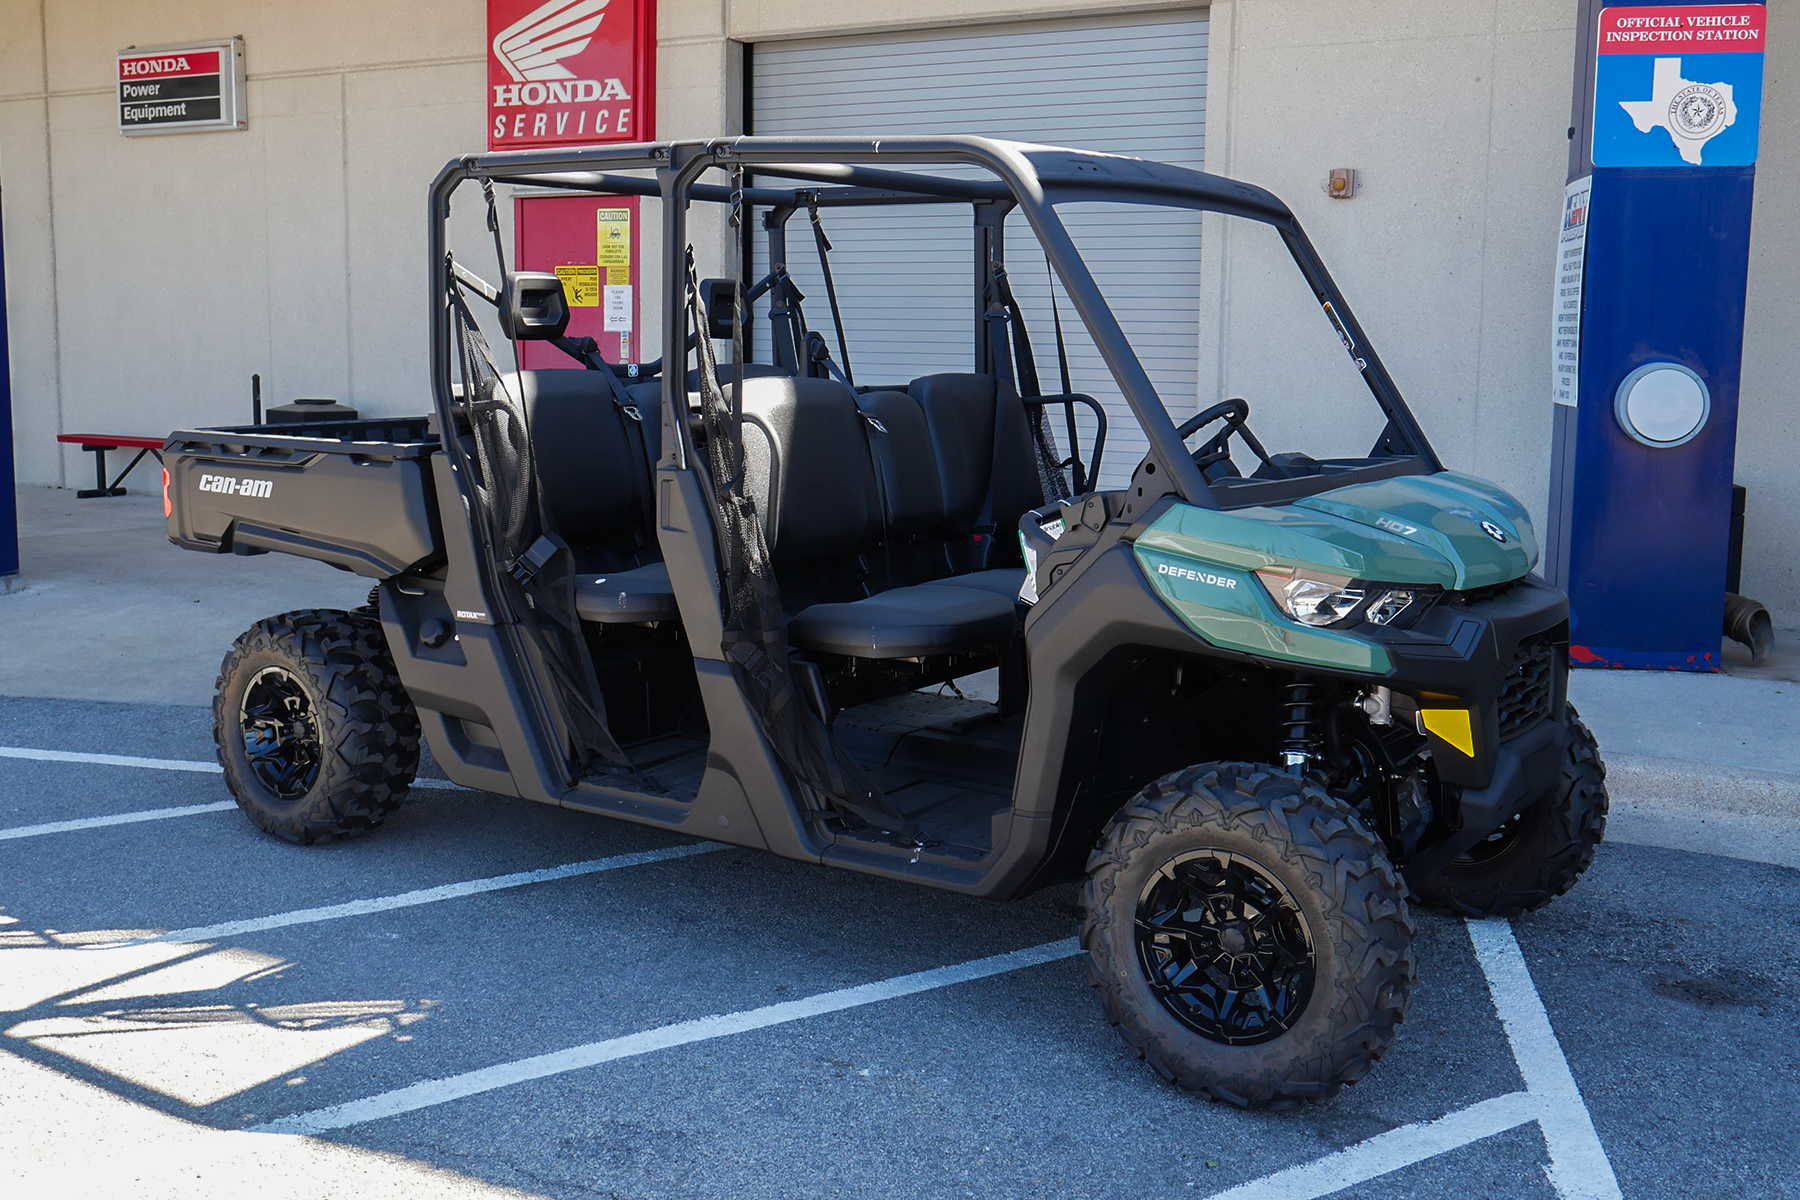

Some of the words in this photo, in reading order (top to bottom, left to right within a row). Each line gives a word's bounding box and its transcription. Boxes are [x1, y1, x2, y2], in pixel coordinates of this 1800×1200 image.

[1616, 16, 1682, 28] OFFICIAL
[1686, 16, 1750, 27] VEHICLE
[1606, 30, 1693, 42] INSPECTION
[1696, 29, 1760, 40] STATION
[122, 58, 190, 76] HONDA
[124, 84, 160, 97] Power
[494, 78, 631, 107] HONDA
[1678, 87, 1700, 98] STATE
[1713, 92, 1724, 115] TEXAS
[124, 102, 186, 121] Equipment
[494, 108, 631, 138] SERVICE
[600, 212, 627, 220] CAUTION
[199, 474, 273, 498] can-am
[1375, 517, 1418, 535] HD7
[1158, 564, 1237, 590] DEFENDER
[457, 610, 478, 619] ROTAX
